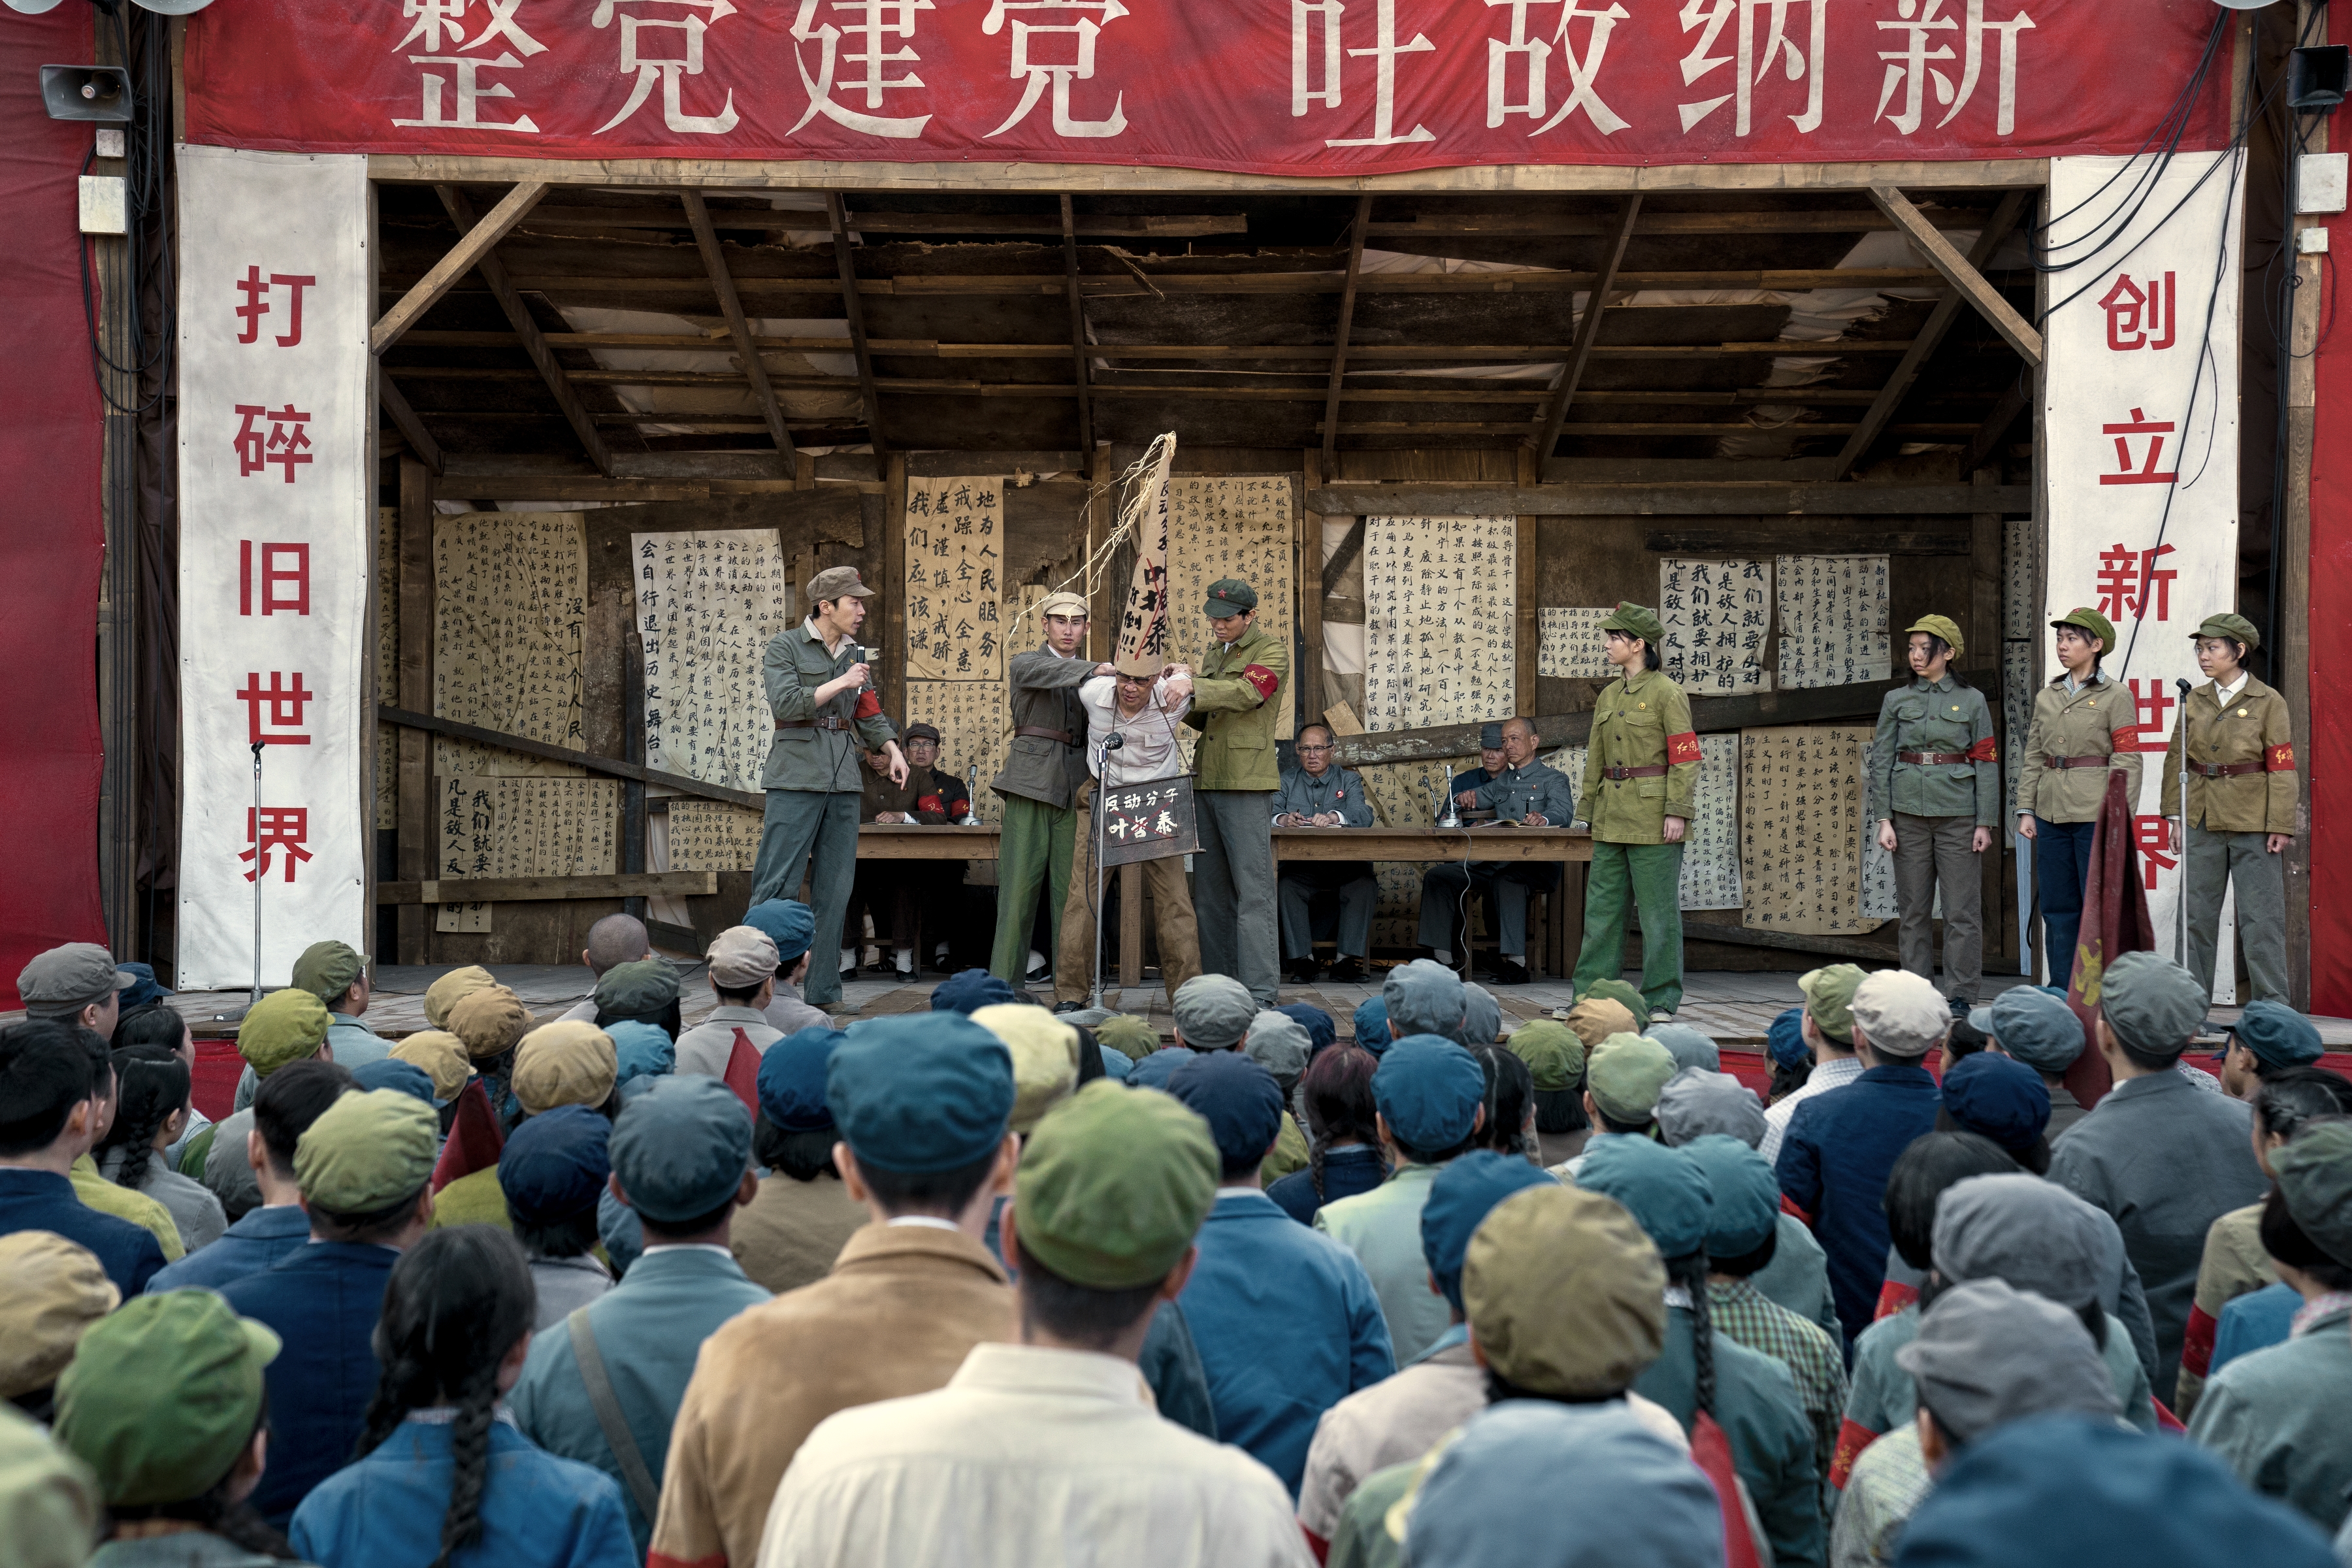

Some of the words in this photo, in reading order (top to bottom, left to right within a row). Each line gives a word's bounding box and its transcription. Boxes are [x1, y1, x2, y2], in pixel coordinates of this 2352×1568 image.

[391, 0, 1128, 139] 整党建党
[1291, 0, 2037, 146] 吐故纳新
[234, 265, 317, 884] 打碎旧世界
[907, 490, 930, 650] 我们应该谦
[954, 484, 975, 673] 戒躁，全心全意
[976, 490, 999, 676] 地为人民服务。
[640, 540, 661, 764] 会自行退出历史舞台。
[1558, 609, 1569, 676] 中国共产党。
[1663, 559, 1687, 685] 凡是敌人反对的
[1741, 560, 1765, 685] 我们就要反对
[670, 802, 681, 870] 领导我们事业
[681, 802, 692, 872] 的核心力量是
[693, 803, 704, 870] 中国共产党。
[702, 803, 714, 872] 指导我们思想
[714, 804, 725, 872] 的理论基础是
[725, 804, 734, 871] 马克思列宁主
[1105, 788, 1179, 813] 反动分子
